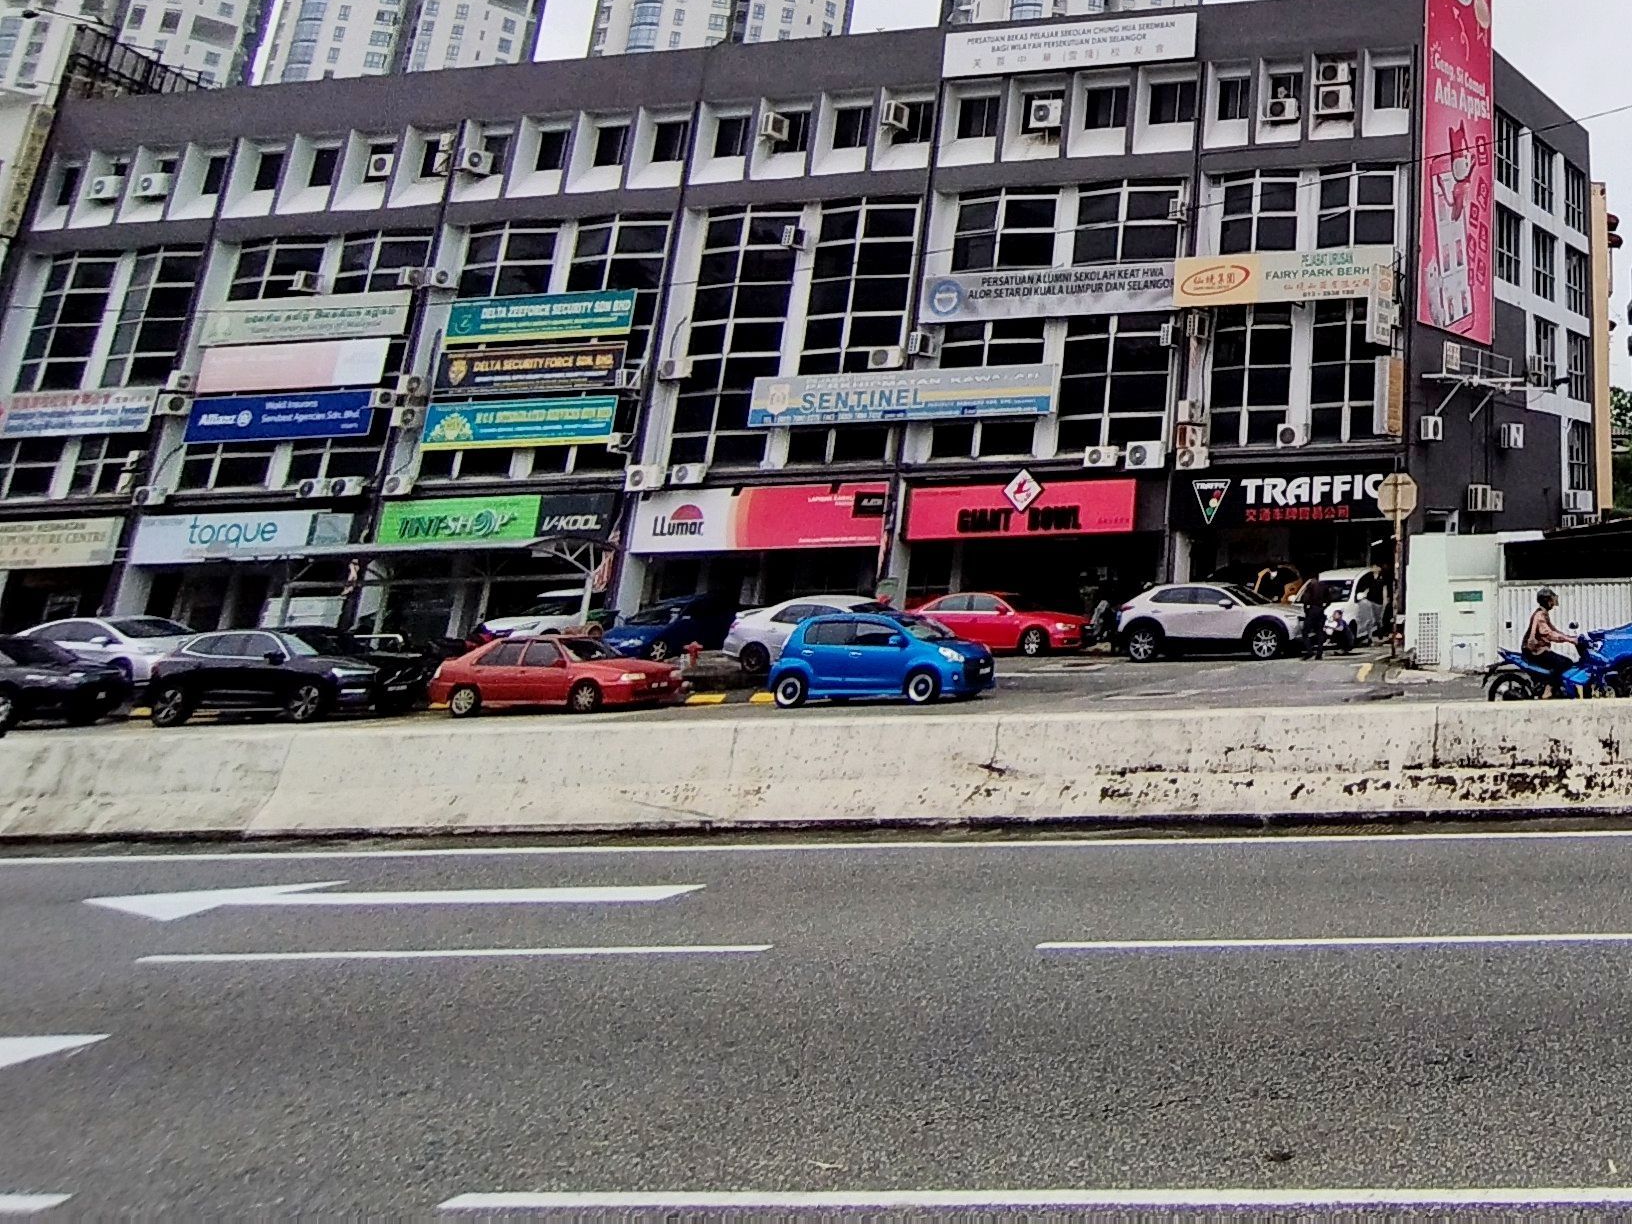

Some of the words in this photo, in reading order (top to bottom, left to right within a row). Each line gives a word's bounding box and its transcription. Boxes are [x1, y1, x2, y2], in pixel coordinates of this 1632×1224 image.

[1093, 26, 1120, 34] CHUNG
[1434, 77, 1458, 109] Ada
[1459, 86, 1491, 122] Apps!
[981, 274, 1034, 287] PERSATUAN
[1073, 270, 1116, 281] SEKOLAH
[1117, 269, 1140, 279] KEAT
[1141, 267, 1164, 277] HWA
[1265, 271, 1298, 280] FAIRY
[1301, 268, 1333, 277] PARK
[968, 289, 992, 299] ALOR
[993, 287, 1021, 298] SETAR
[1022, 286, 1032, 296] DI
[1033, 284, 1065, 296] KUALA
[1066, 282, 1103, 294] LUMPUR
[1105, 280, 1126, 291] DAN
[800, 387, 924, 414] SENTINEL
[1240, 473, 1384, 506] TRAFFIC
[542, 514, 602, 531] V-KOOL
[652, 516, 704, 536] LLumar
[956, 508, 1014, 532] GIANT
[1026, 504, 1082, 531] BOWL
[188, 516, 278, 547] torque
